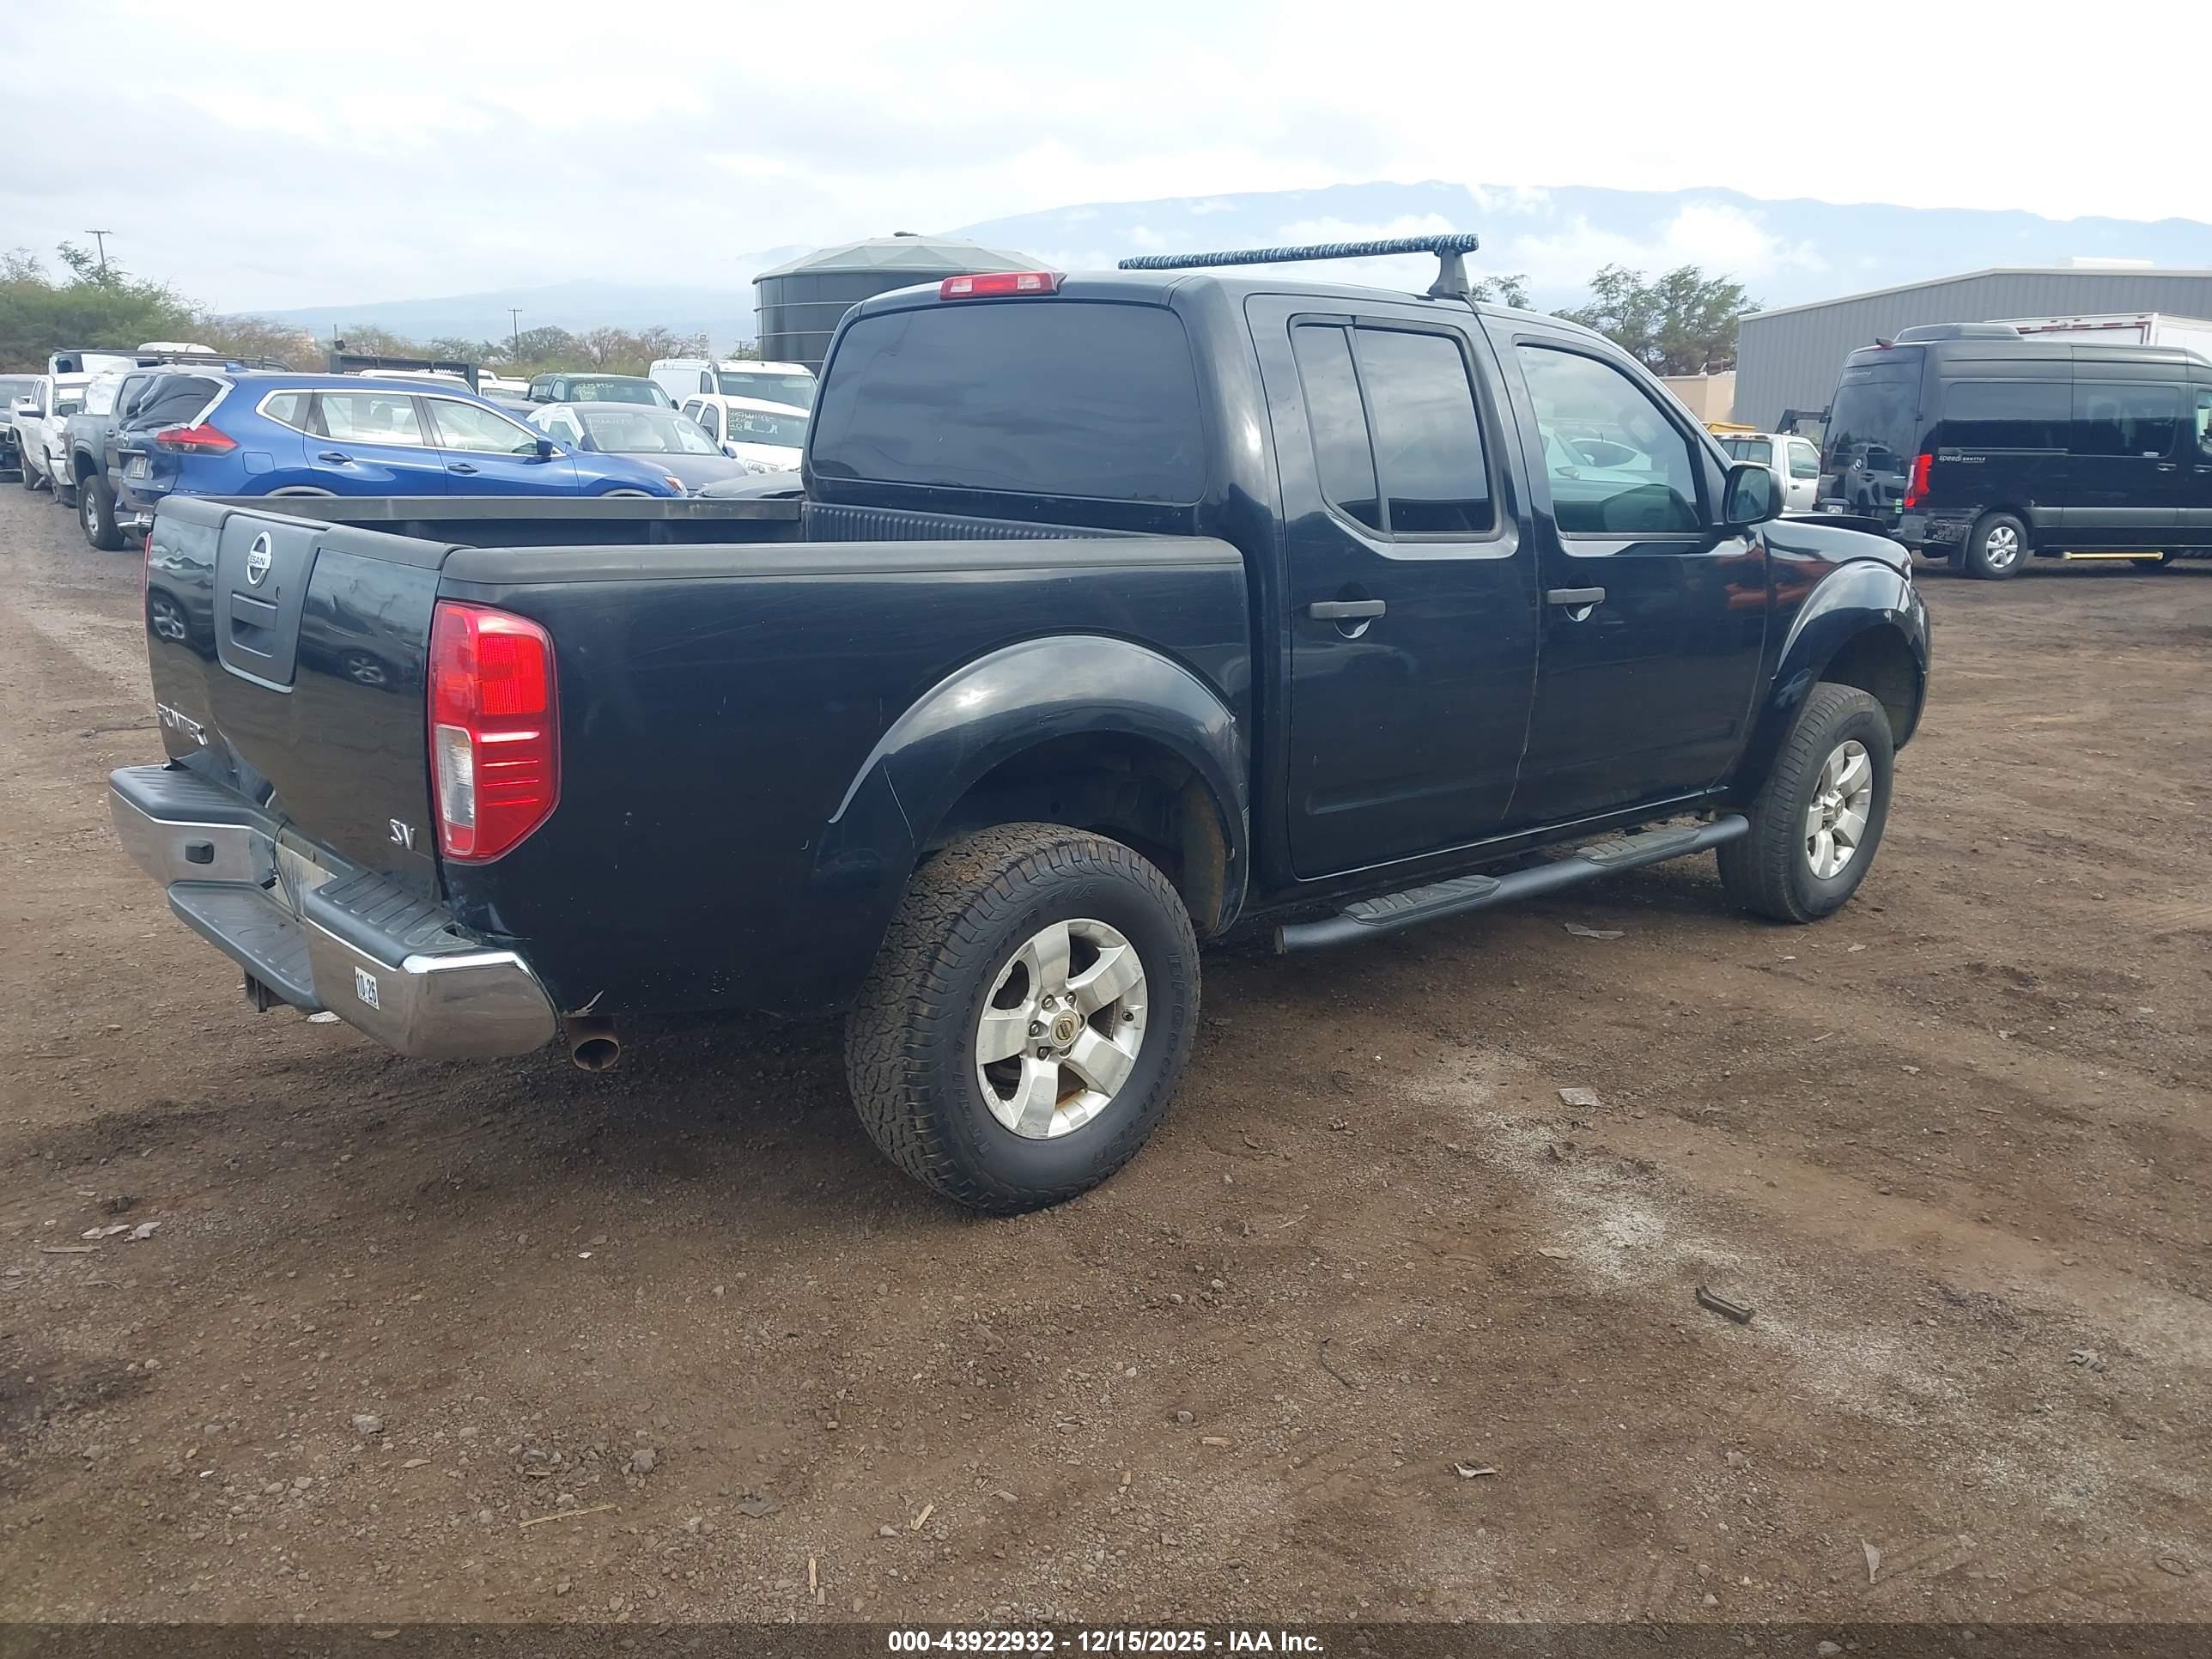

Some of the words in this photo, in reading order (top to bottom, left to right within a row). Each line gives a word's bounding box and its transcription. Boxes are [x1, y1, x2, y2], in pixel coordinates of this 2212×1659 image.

[157, 702, 208, 745] FRONTIER
[389, 818, 416, 854] SV
[356, 972, 366, 997] 10
[367, 978, 377, 1003] 26
